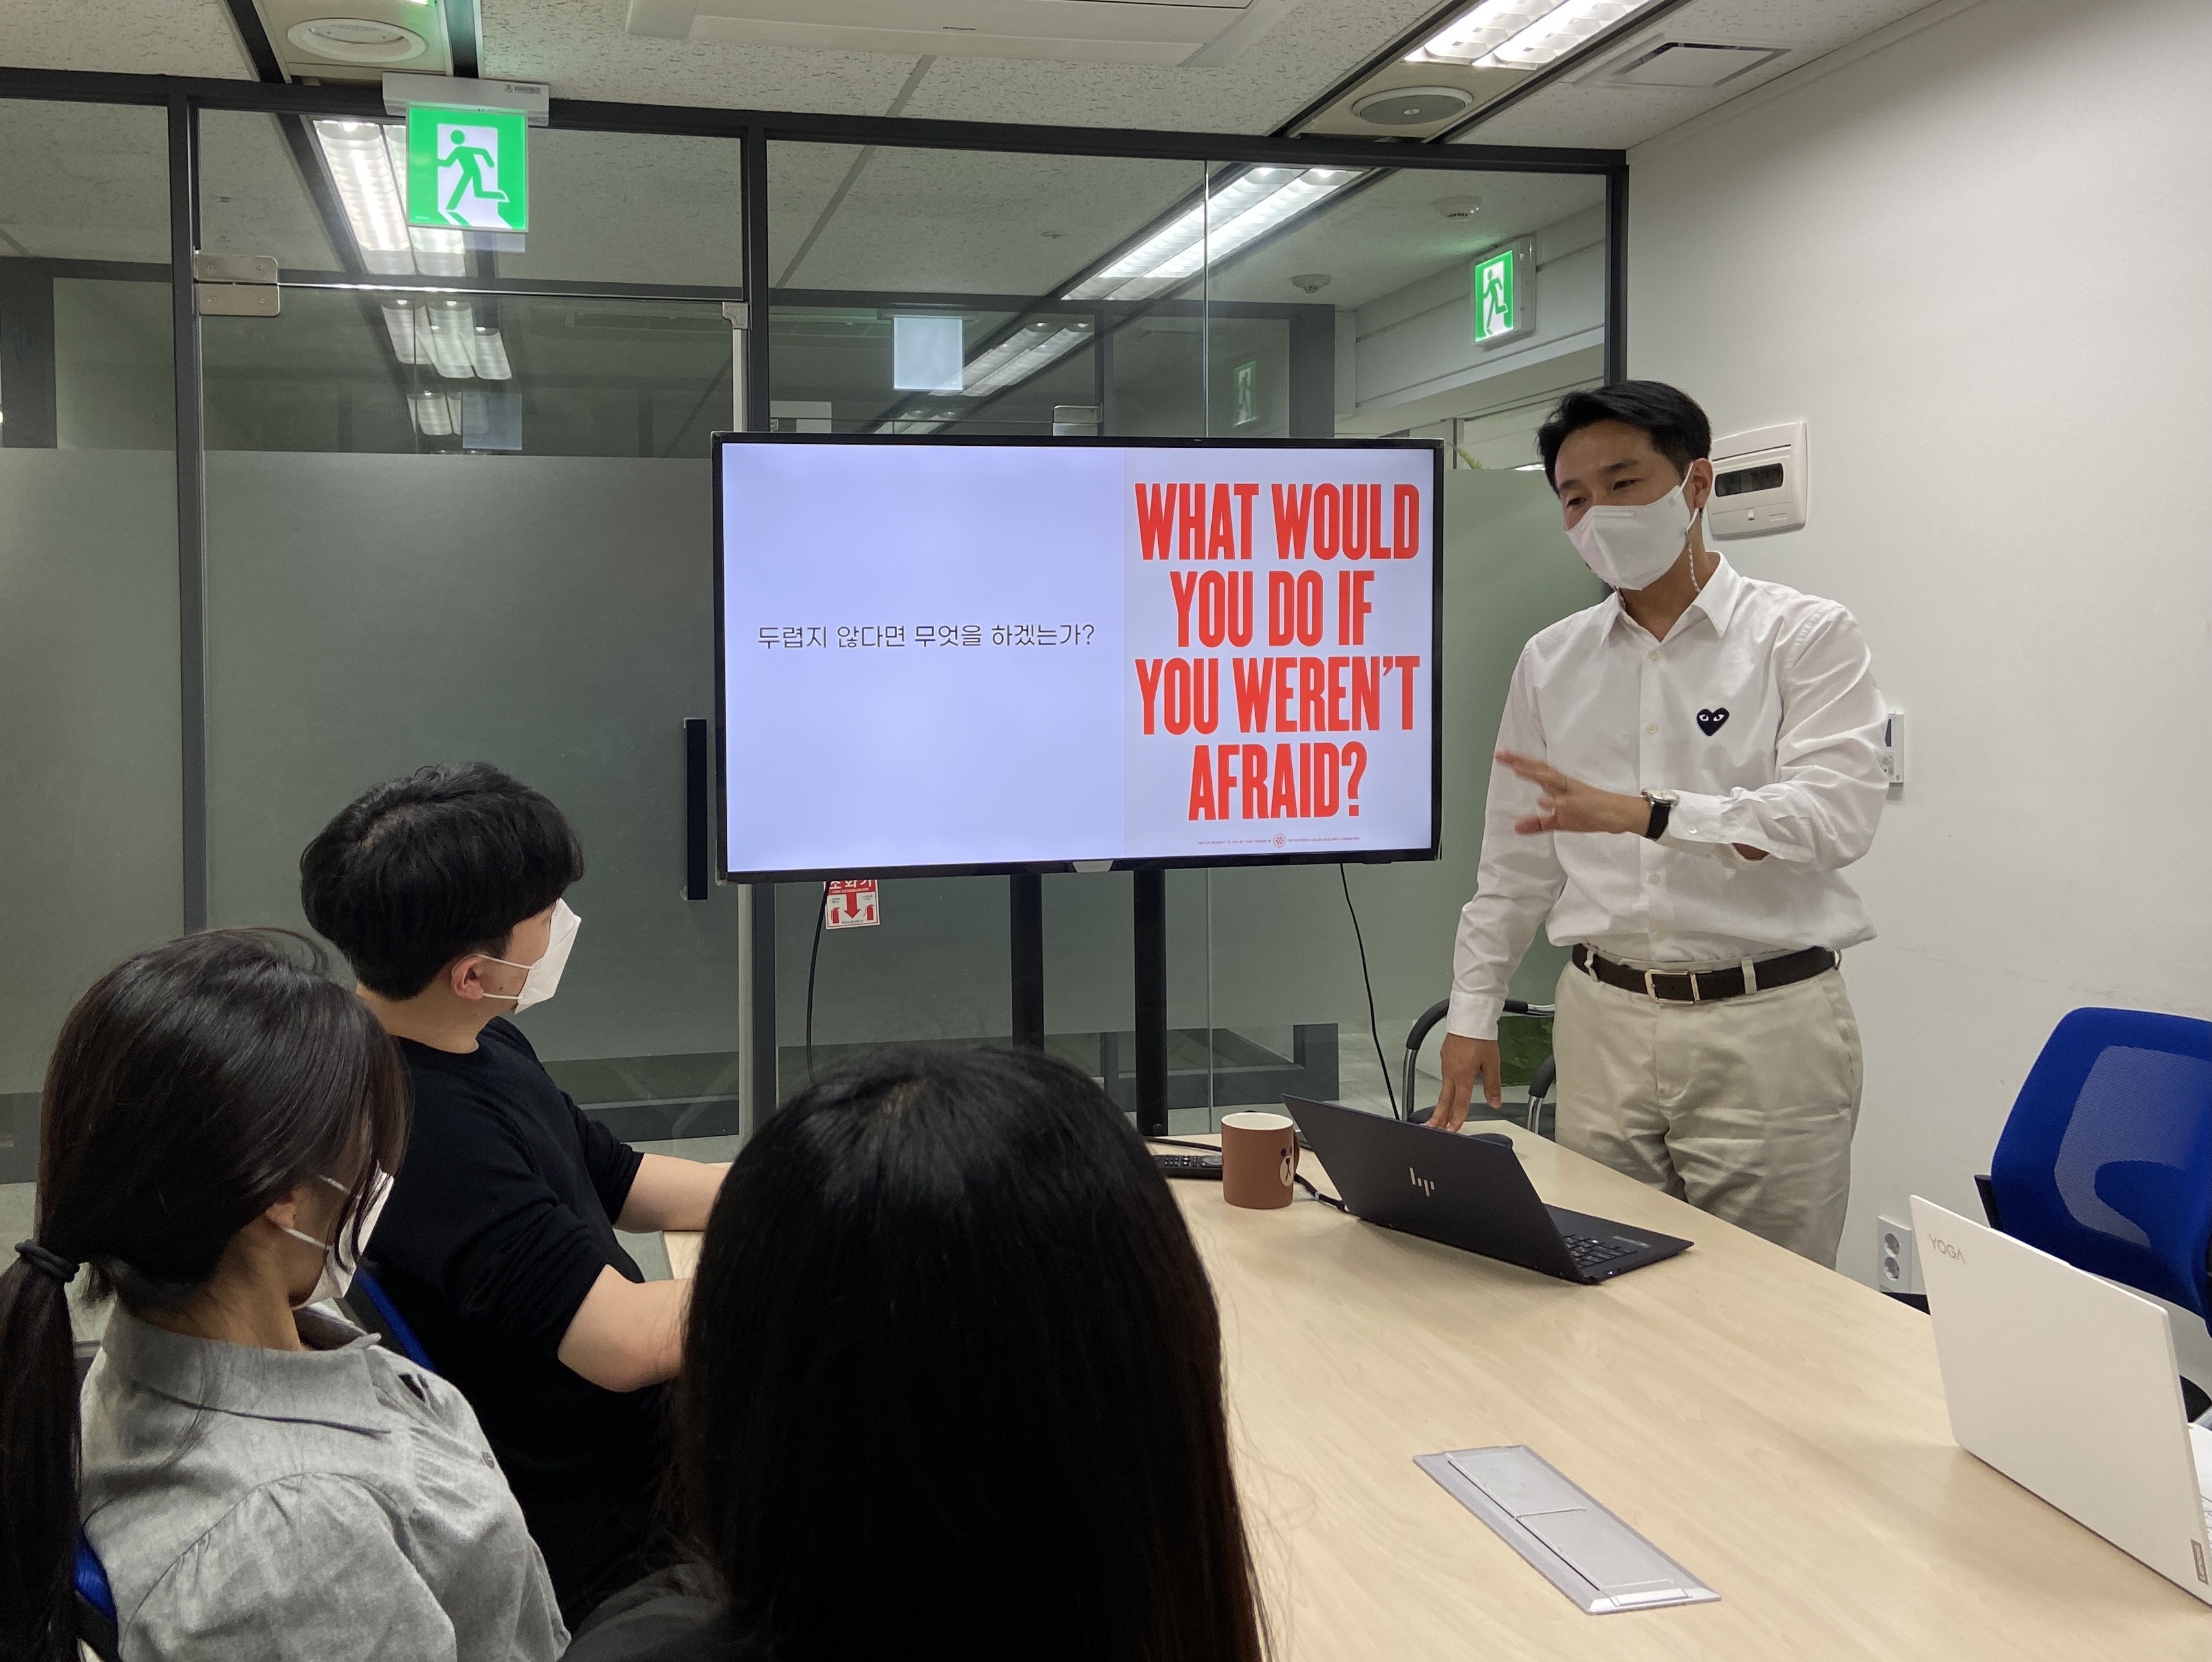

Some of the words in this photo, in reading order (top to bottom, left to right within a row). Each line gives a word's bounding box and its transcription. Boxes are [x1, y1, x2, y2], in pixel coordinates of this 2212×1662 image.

[1135, 483, 1259, 560] WHAT
[1271, 483, 1419, 560] WOULD
[758, 626, 827, 649] 두렵지
[838, 626, 905, 648] 않다면
[915, 625, 982, 647] 무엇을
[991, 624, 1095, 646] 하겠는가?
[1170, 570, 1253, 648] YOU
[1268, 570, 1323, 647] DO
[1339, 570, 1374, 646] IF
[1135, 658, 1219, 735] YOU
[1233, 656, 1420, 733] WEREN'T
[1189, 741, 1367, 821] AFRAID?
[1928, 1233, 1966, 1264] YOGA
